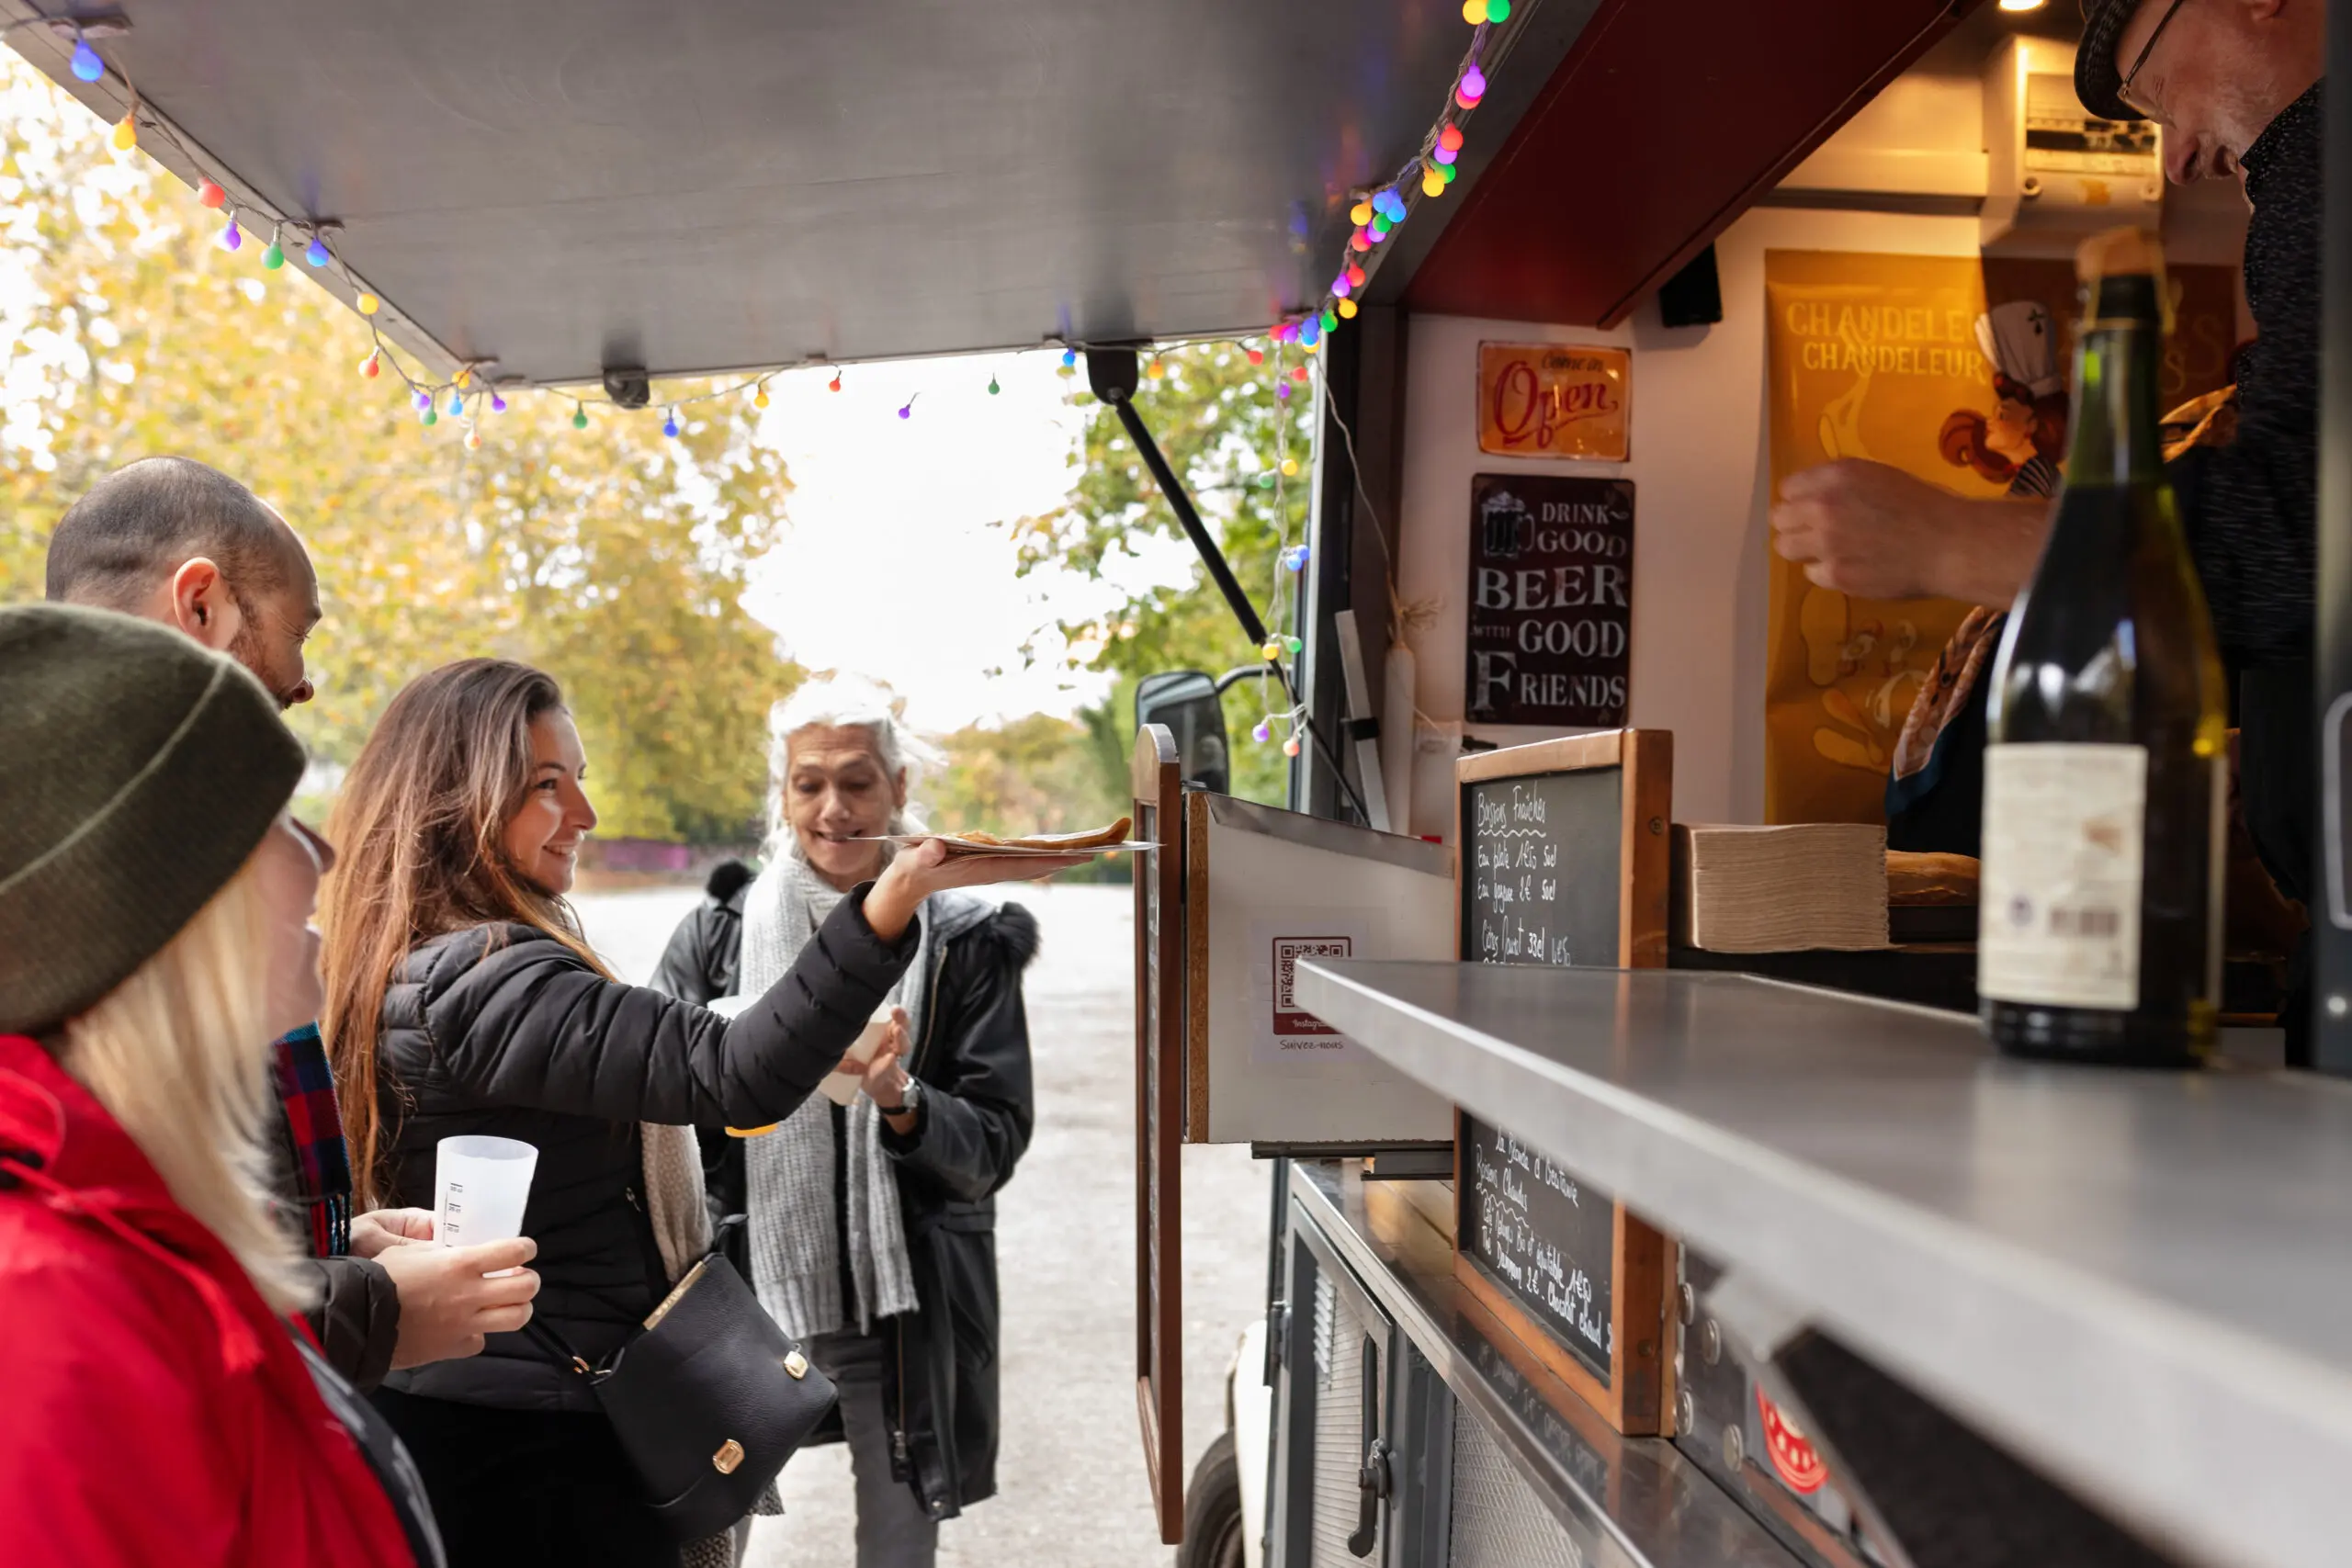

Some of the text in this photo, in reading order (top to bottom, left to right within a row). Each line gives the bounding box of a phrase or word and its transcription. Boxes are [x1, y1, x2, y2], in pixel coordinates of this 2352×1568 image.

[1786, 301, 1976, 343] CHANDELE
[1803, 341, 1986, 386] CHANDELEUR
[1493, 359, 1619, 449] Open
[1541, 502, 1610, 525] DRINK
[1536, 528, 1627, 558] GOOD
[1474, 564, 1629, 611] BEER
[1473, 618, 1625, 659] WITH GOOD
[1473, 649, 1626, 711] FRIENDS
[1279, 1039, 1345, 1051] Suivez-nous
